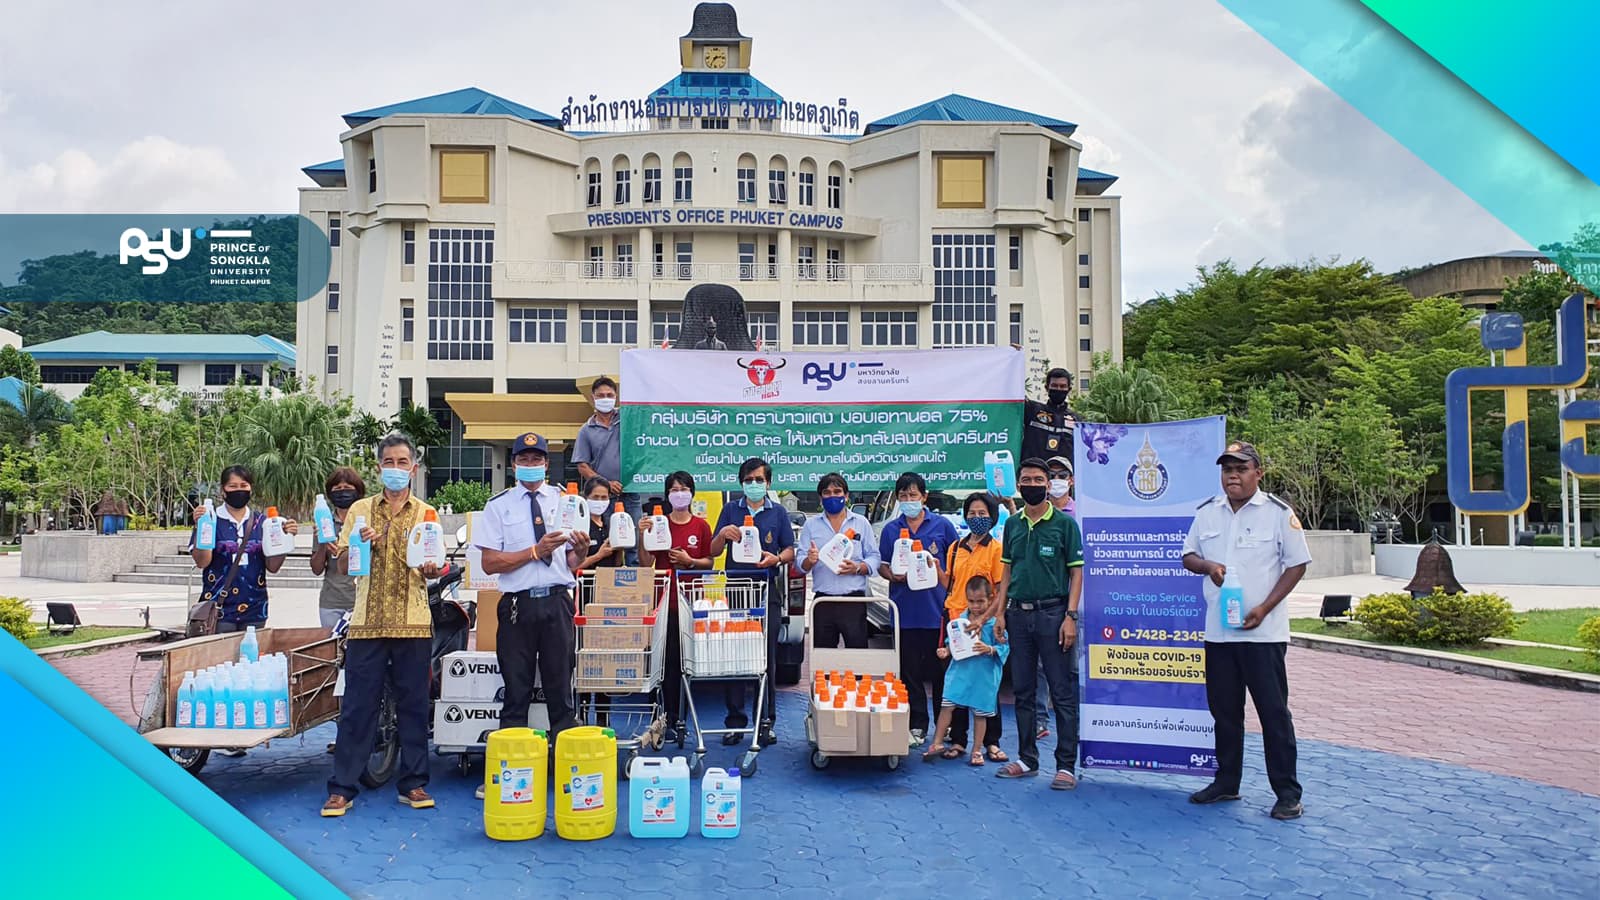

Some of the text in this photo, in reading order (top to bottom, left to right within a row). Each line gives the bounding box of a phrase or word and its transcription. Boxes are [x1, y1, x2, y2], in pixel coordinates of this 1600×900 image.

[561, 86, 859, 133] สำนักงานอธิการบดี วิทยาเขตภูเก็ต
[587, 209, 843, 229] PRESIDENT'S OFFICE PHUKET CAMPUS
[857, 368, 900, 376] มหาวิทยาลัย
[857, 376, 910, 385] สงขลานครินทร์
[651, 409, 988, 428] กลุ่มบริษัท คาราบาวแดง มอบเอทานอล 75%
[636, 428, 1009, 447] จำนวน 10,000 ลิตร ให้มหาวิทยาลัยสงขลานครินทร์
[778, 472, 803, 482] ยะลา
[1086, 530, 1188, 546] ศูนย์บรรเทาและการช่ว
[1094, 547, 1164, 559] ช่วงสถานการณ์
[1160, 593, 1197, 602] Service
[1104, 606, 1123, 616] ครบ
[1125, 607, 1139, 616] จบ
[1107, 648, 1202, 665] ฟังข้อมูล COVID-19
[468, 664, 501, 674] VENU
[1099, 662, 1206, 678] บริจาคหรือขอรับบริจา
[464, 709, 501, 719] VENU
